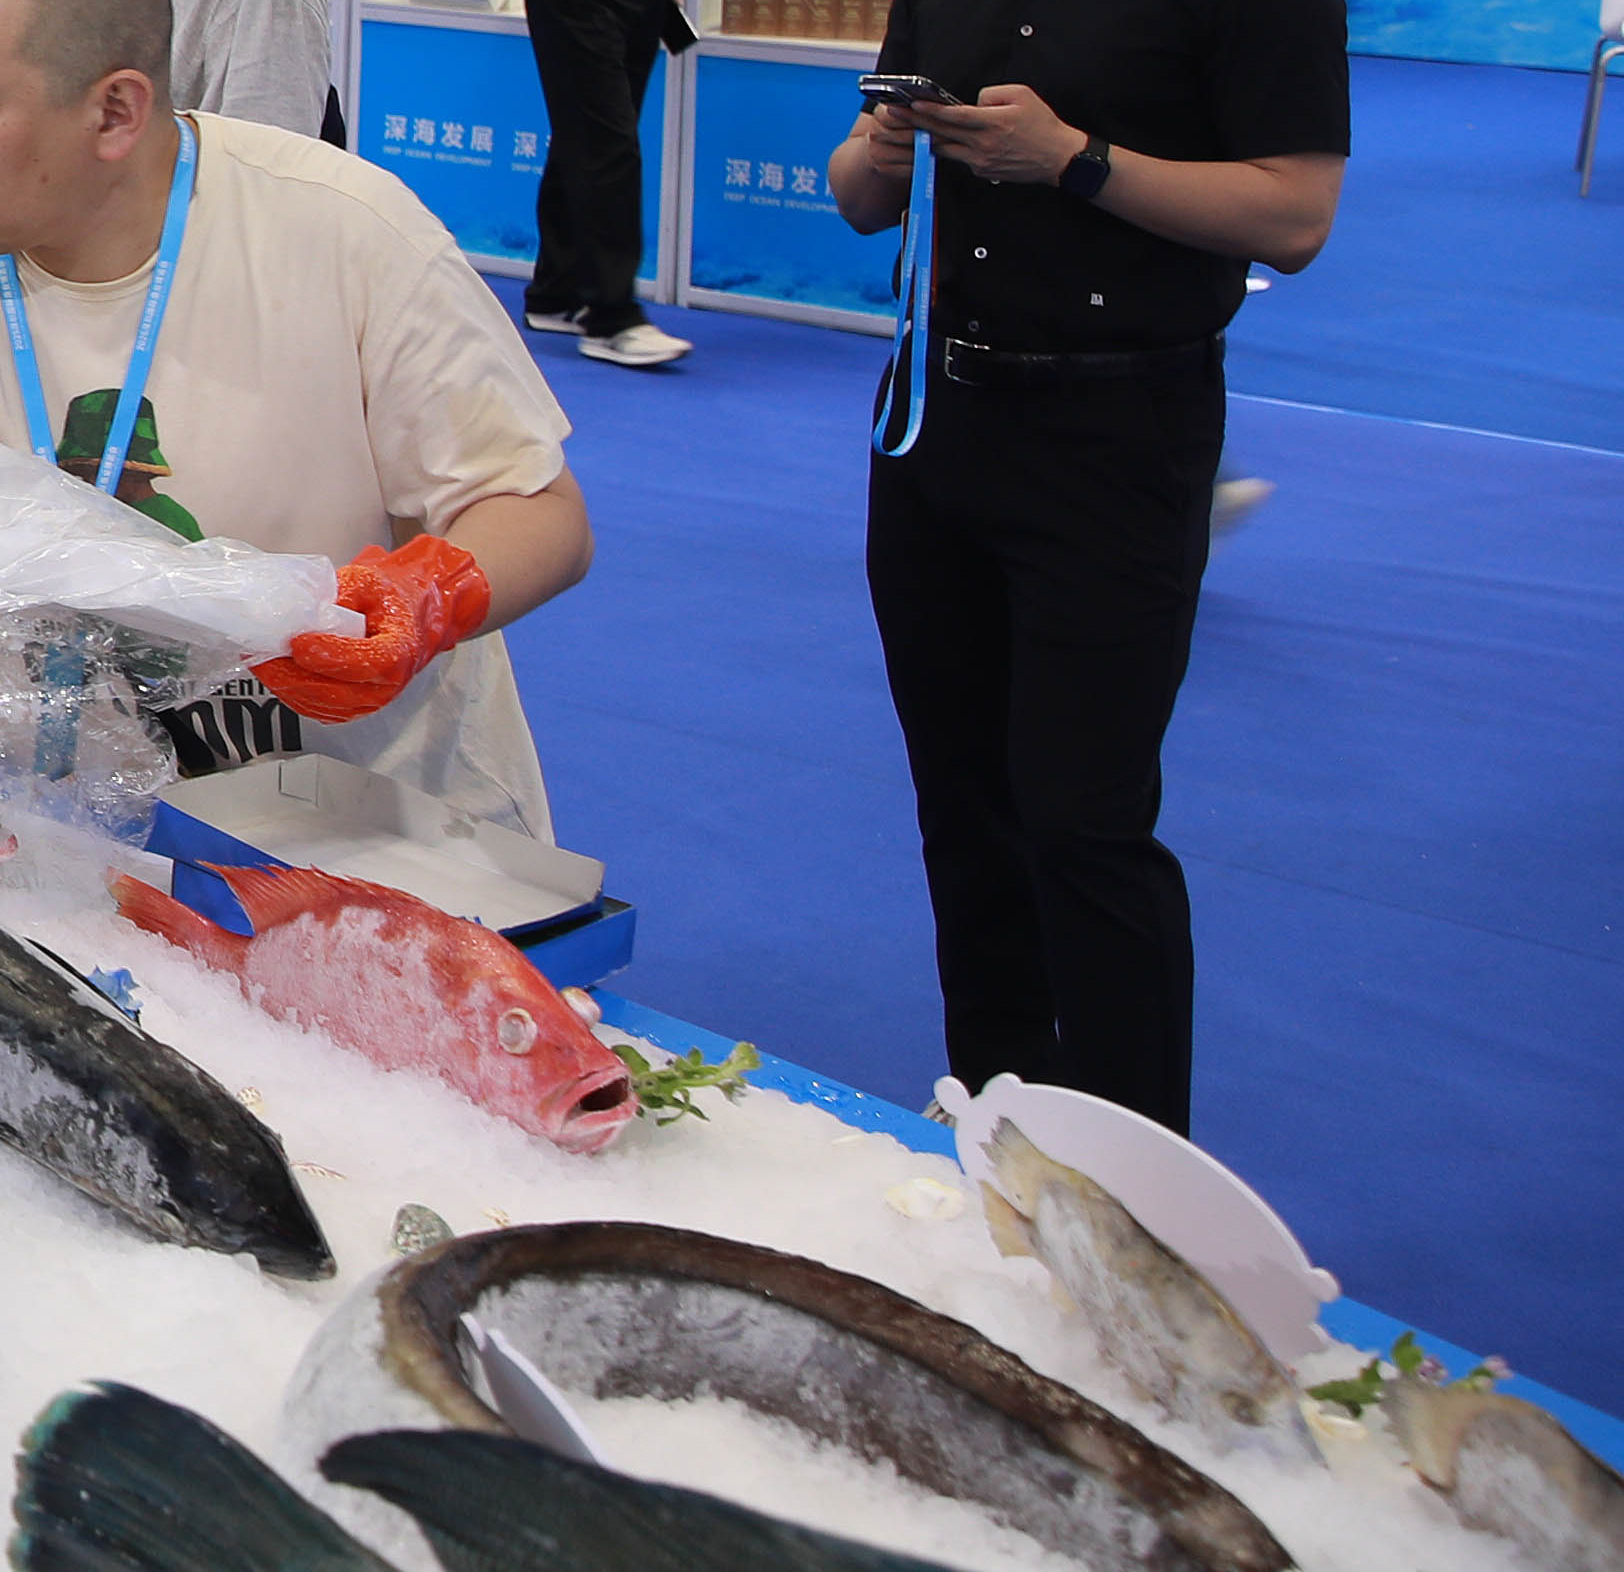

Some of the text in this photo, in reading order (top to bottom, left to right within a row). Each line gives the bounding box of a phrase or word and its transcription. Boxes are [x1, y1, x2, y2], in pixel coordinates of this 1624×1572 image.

[384, 114, 551, 159] 深海发展 深
[725, 157, 833, 196] 深海发
